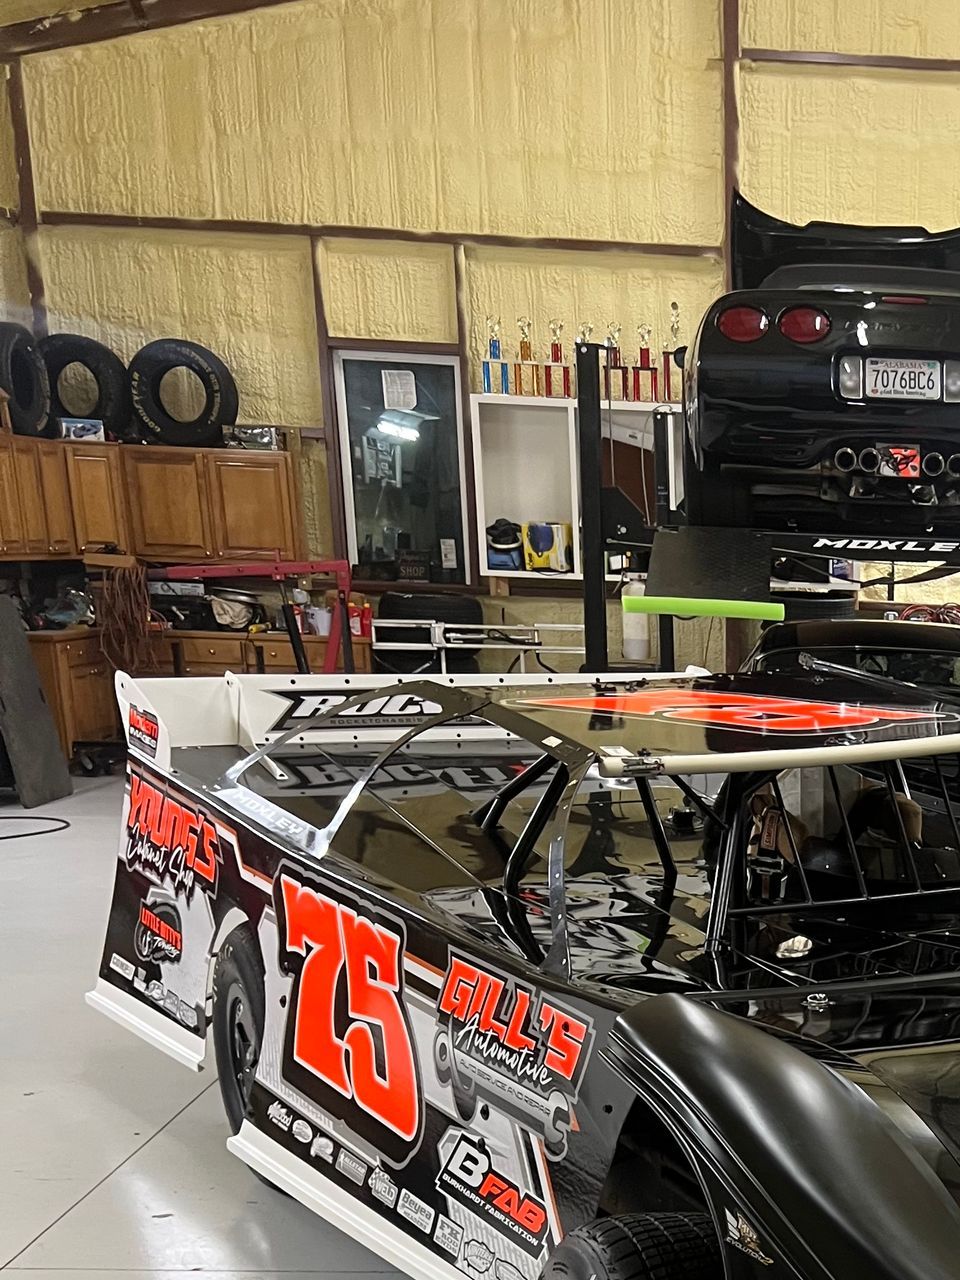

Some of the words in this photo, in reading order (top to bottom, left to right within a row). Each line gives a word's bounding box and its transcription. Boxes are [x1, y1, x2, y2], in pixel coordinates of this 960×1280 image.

[872, 369, 935, 390] 7076BC6
[883, 361, 923, 369] ALABAMA
[399, 566, 425, 577] SHOP
[128, 773, 218, 883] YOUNG'S
[127, 822, 167, 873] Cabinet
[169, 848, 195, 893] Shop
[280, 873, 419, 1142] 75
[439, 955, 588, 1081] GILL'S
[455, 1012, 553, 1086] Automotive
[402, 1192, 432, 1221] Beyea
[442, 1173, 485, 1207] BURKHARDT
[485, 1203, 539, 1247] FABRICATION
[435, 1233, 458, 1256] ENDS
[439, 1220, 461, 1242] FK
[441, 1232, 459, 1249] ROD
